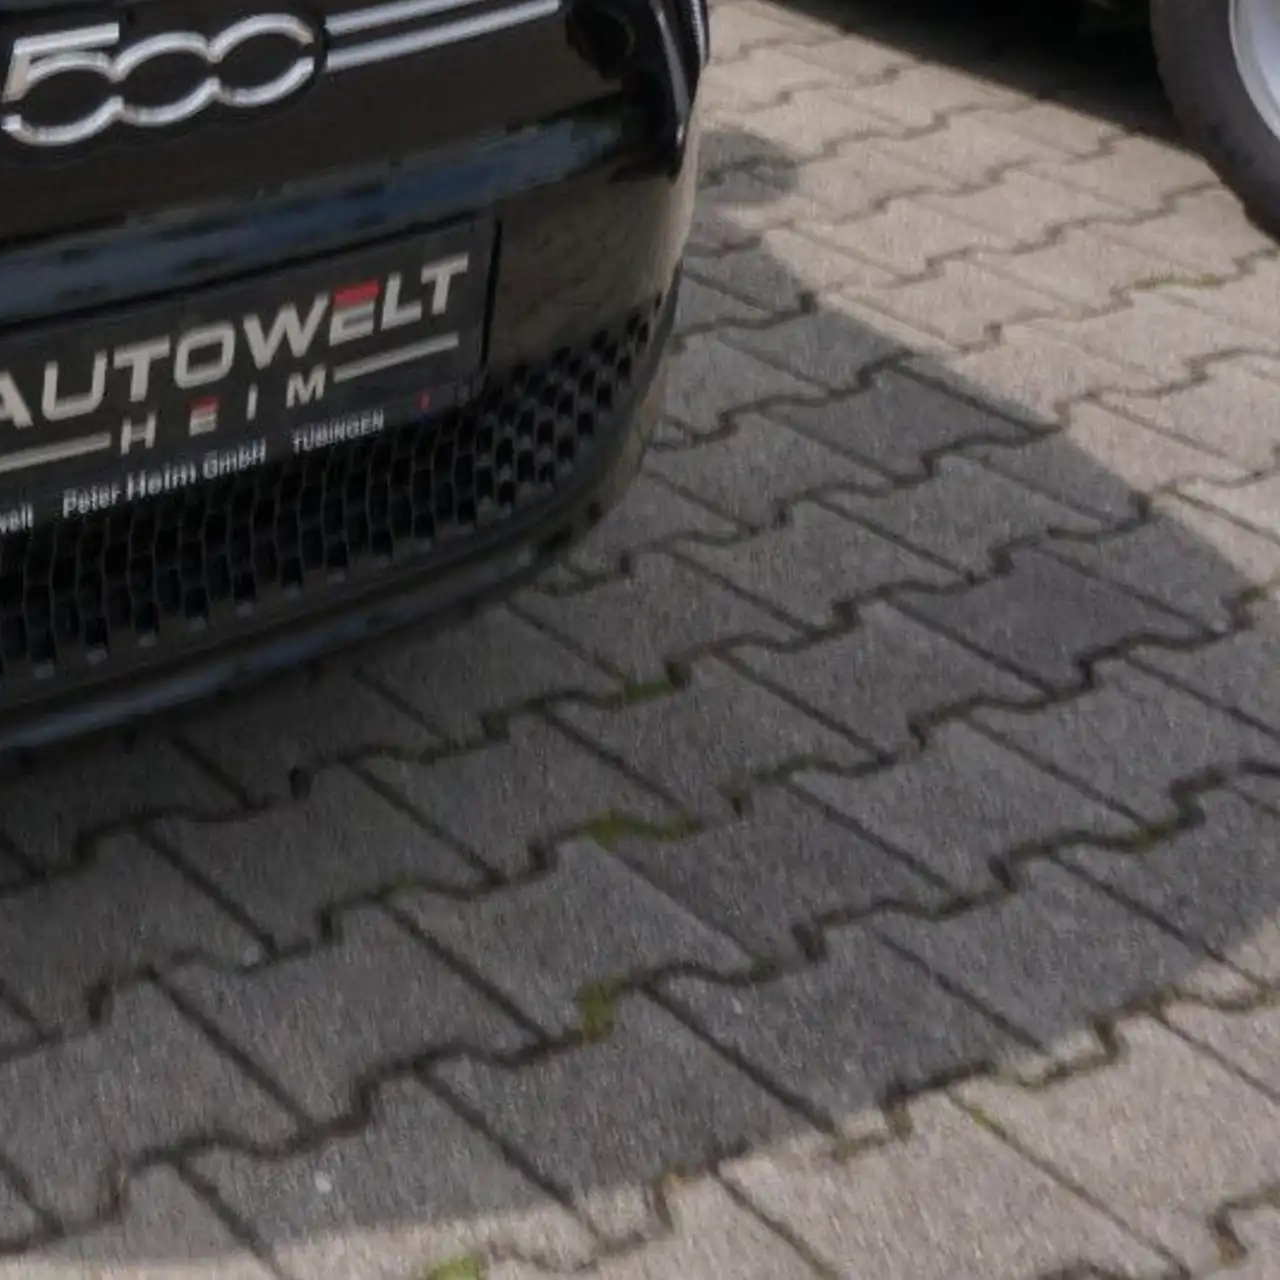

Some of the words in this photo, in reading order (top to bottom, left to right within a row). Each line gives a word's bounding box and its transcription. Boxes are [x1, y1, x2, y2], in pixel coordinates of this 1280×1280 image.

[2, 14, 314, 145] 500
[120, 365, 327, 456] HEIM
[62, 486, 122, 519] Peter
[202, 438, 268, 480] GmbH
